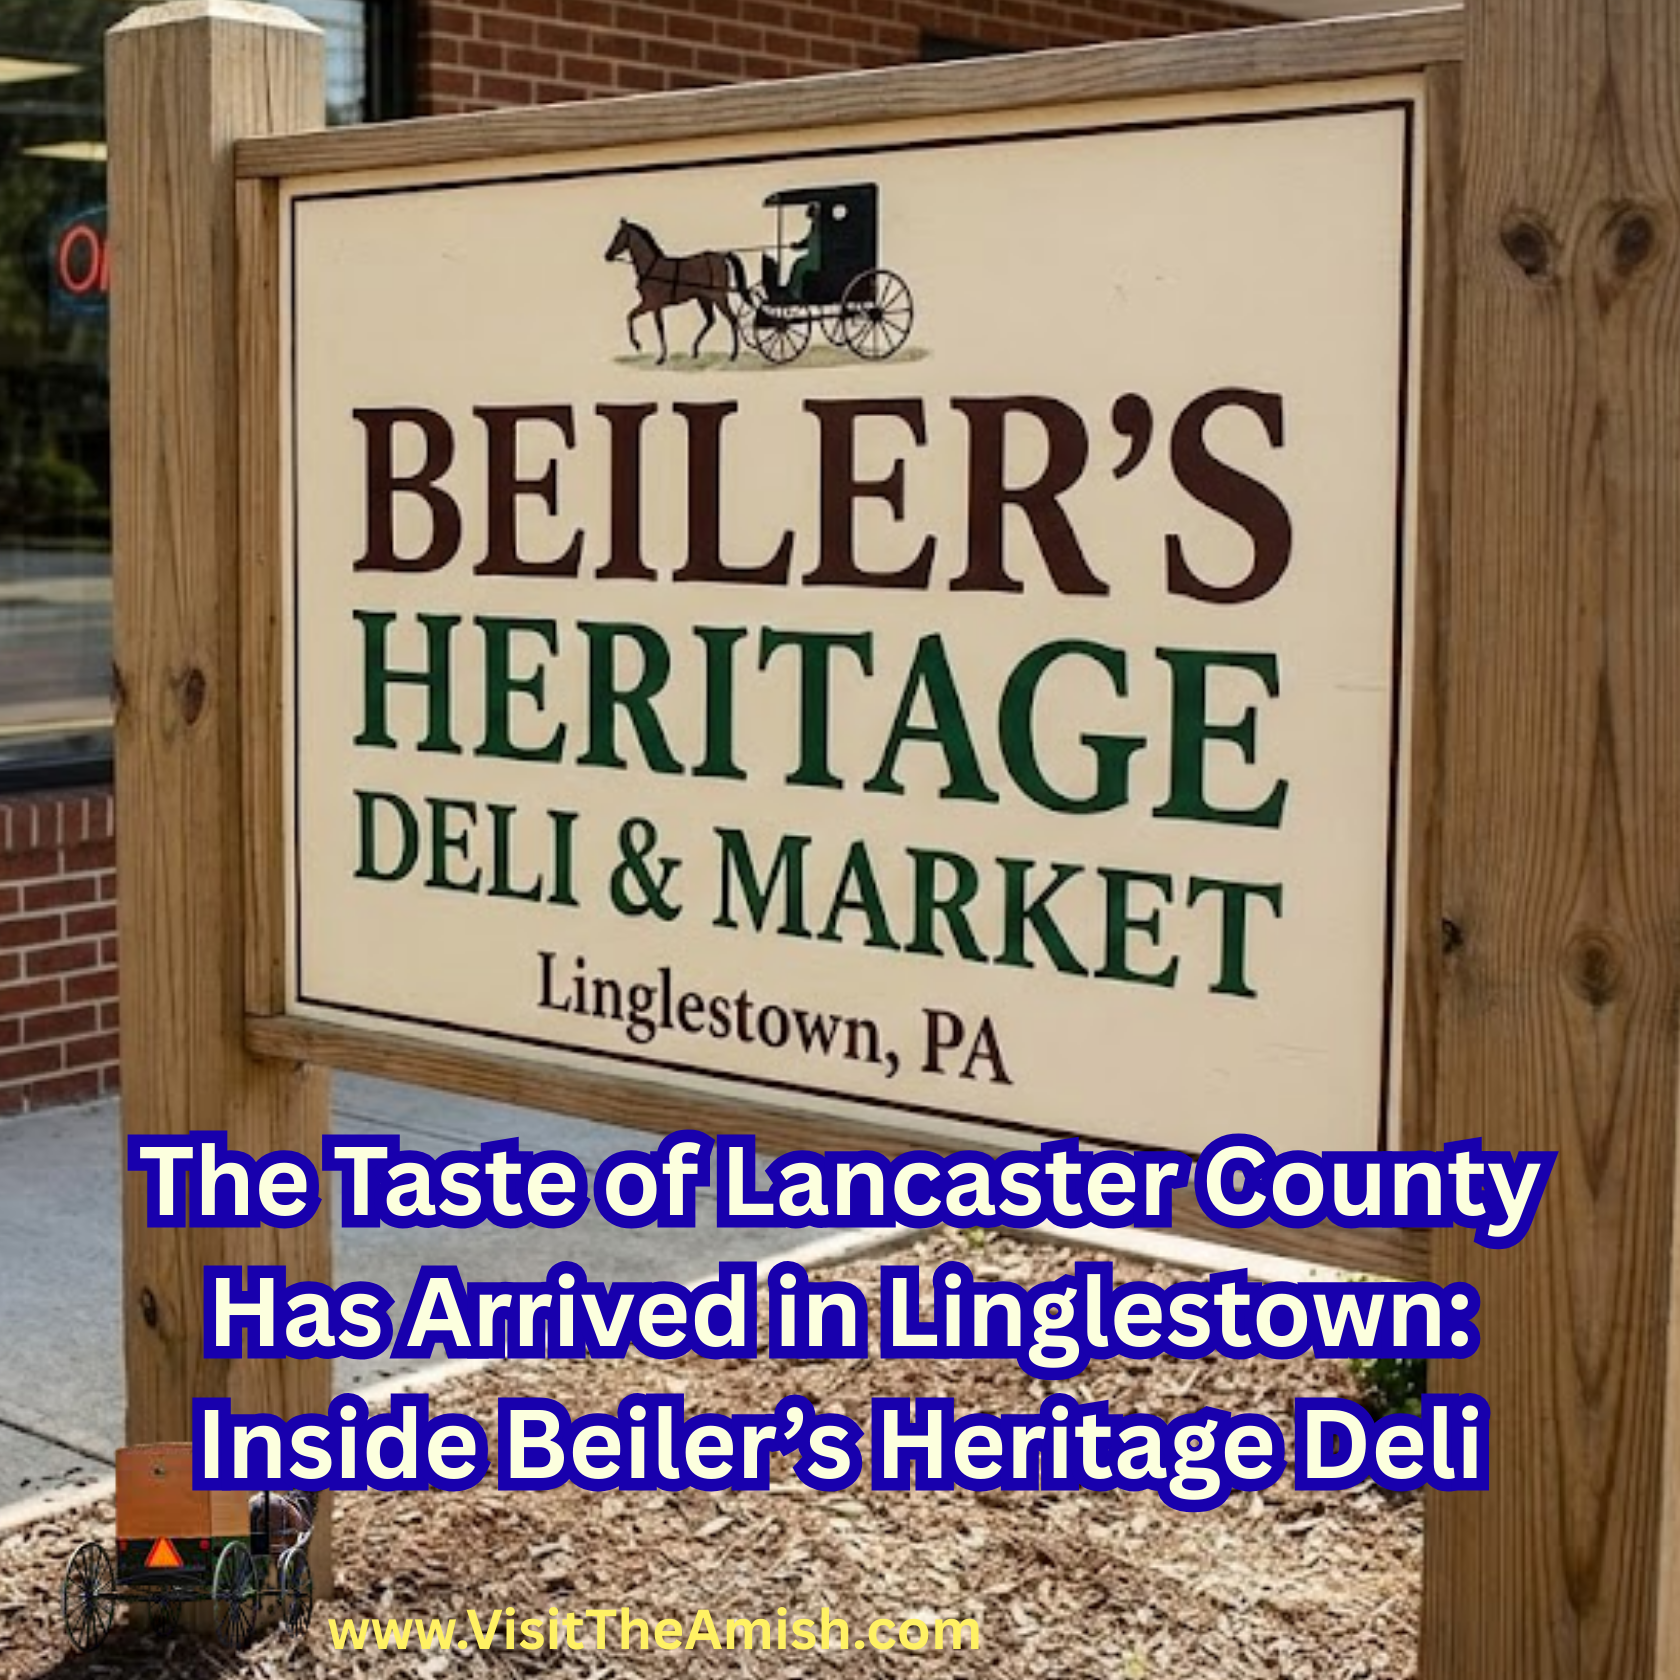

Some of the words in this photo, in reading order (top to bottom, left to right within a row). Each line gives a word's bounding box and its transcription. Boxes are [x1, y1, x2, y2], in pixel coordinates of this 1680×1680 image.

[352, 388, 1294, 605] BEILER’S
[352, 609, 1289, 830] HERITAGE
[353, 789, 580, 908] DELI
[608, 816, 683, 922] &
[712, 826, 1284, 999] MARKET
[536, 950, 901, 1079] Linglestown,
[921, 1008, 1014, 1086] PA
